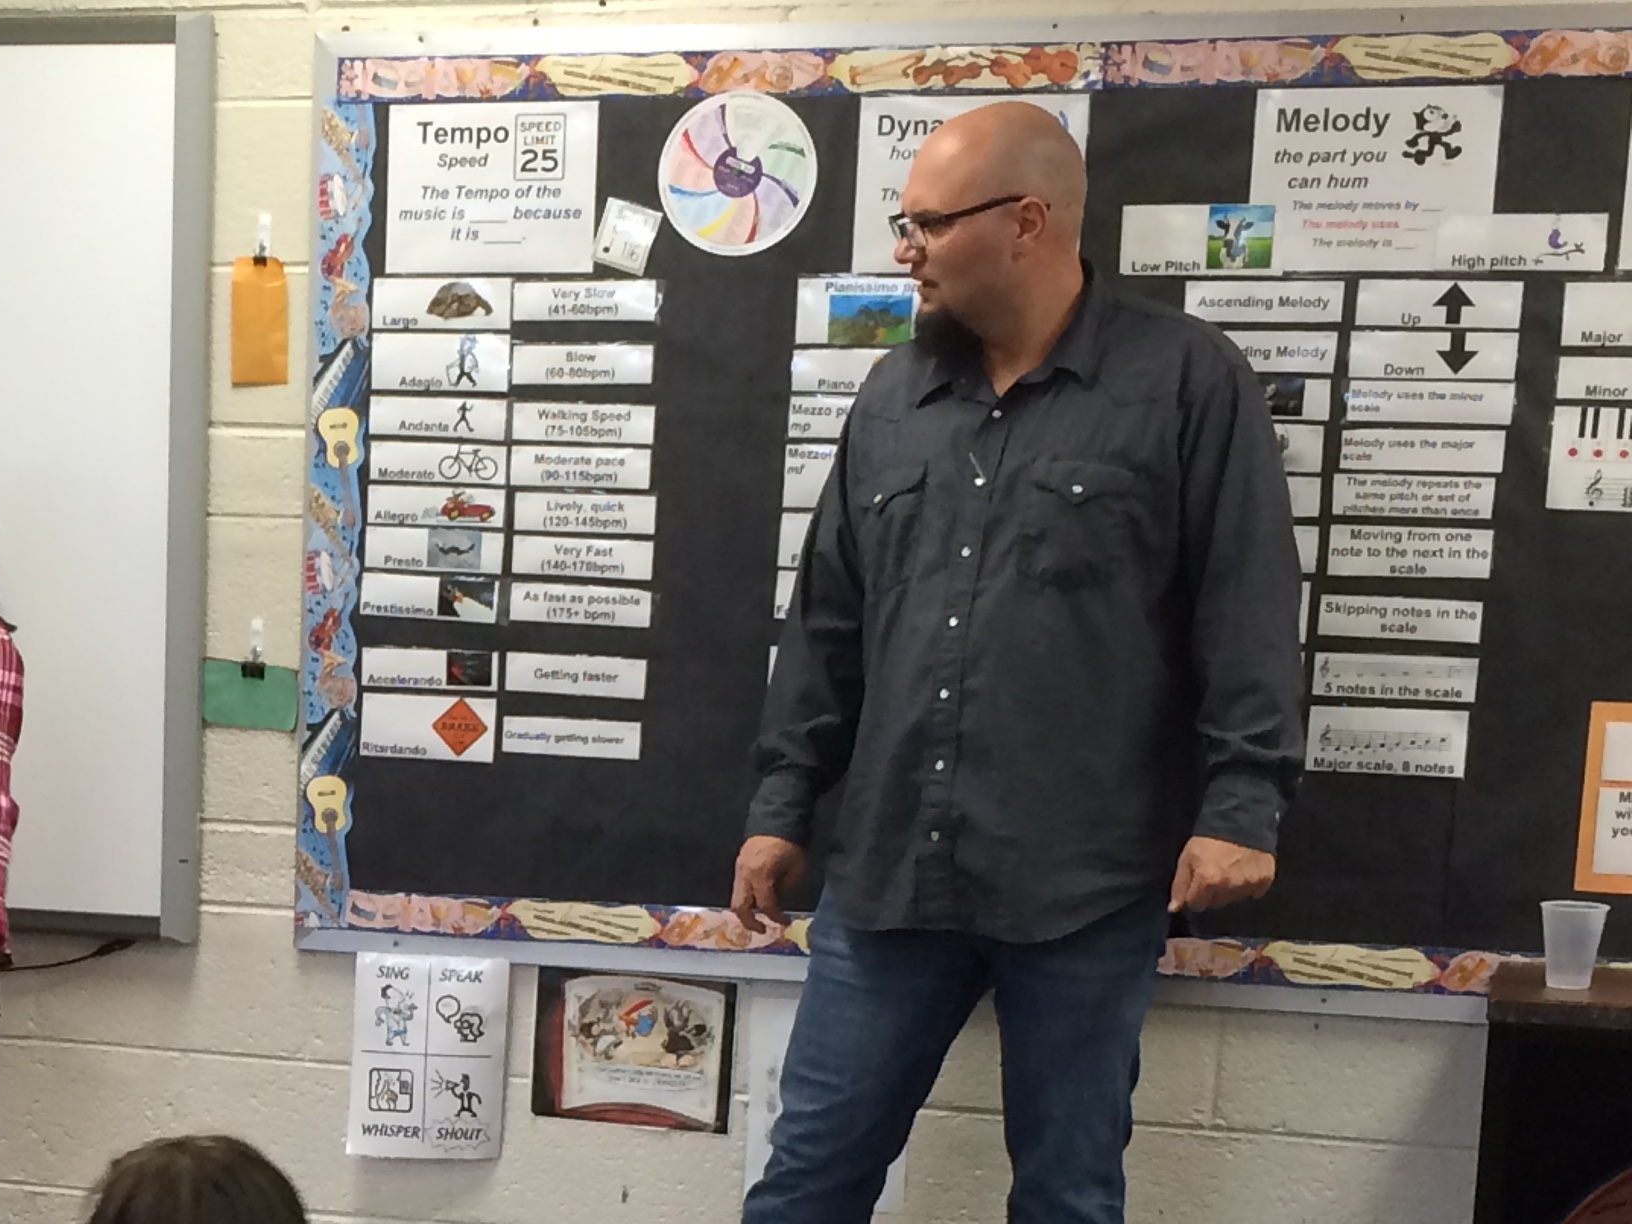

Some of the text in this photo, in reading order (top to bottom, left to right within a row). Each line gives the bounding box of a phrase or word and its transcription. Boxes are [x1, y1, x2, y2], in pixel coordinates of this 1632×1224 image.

[520, 121, 561, 133] SPEED
[877, 115, 944, 142] Dyna
[1276, 107, 1390, 138] Melody
[417, 121, 509, 149] Tempo
[524, 135, 556, 146] LIMIT
[437, 153, 489, 170] Speed
[520, 149, 559, 173] 25
[1274, 149, 1387, 167] the part you
[1288, 175, 1369, 189] can hum
[421, 185, 561, 202] The Tempo of the
[399, 206, 582, 221] music is because
[1292, 201, 1419, 212] The melody moves by
[1302, 220, 1399, 231] The melody uses
[450, 227, 479, 241] it is
[1312, 238, 1379, 249] The melody
[1132, 260, 1200, 273] Low Pitch
[1451, 254, 1527, 270] High pitch
[552, 288, 616, 300] Very Slow
[826, 282, 898, 293] Pianissimo
[1197, 296, 1330, 311] Ascending Melody
[382, 316, 418, 329] Largo
[1401, 313, 1421, 327] Up
[1581, 330, 1623, 347] Major
[566, 352, 596, 363] Slow
[1276, 346, 1327, 360] Melody
[545, 366, 616, 380] (60-80bpm)
[1384, 364, 1425, 377] Down
[399, 376, 443, 390] Adagio
[818, 379, 855, 390] Piano
[1352, 389, 1484, 401] Melody uses the minor
[1585, 385, 1628, 398] Minor
[791, 404, 832, 416] Mezzo
[1350, 402, 1380, 412] scale
[537, 409, 631, 424] Walking Speed
[399, 420, 449, 432] Andante
[790, 422, 811, 434] mp
[1344, 437, 1475, 451] Melody uses the major
[534, 454, 625, 469] Moderate pace
[1342, 451, 1372, 461] scale
[378, 468, 435, 480] Moderato
[787, 464, 805, 475] mf
[1347, 477, 1482, 490] The melody repeats the
[1390, 490, 1417, 501] pitch
[1437, 492, 1455, 501] set
[1458, 492, 1470, 502] of
[590, 502, 625, 515] quick
[1421, 505, 1446, 515] than
[1451, 507, 1479, 516] once
[375, 511, 418, 524] Allegro
[1350, 528, 1472, 543] Moving from one
[554, 545, 613, 558] Very Fast
[1331, 546, 1488, 560] note to the next in the
[384, 555, 423, 568] Presto
[1389, 563, 1427, 575] scale
[523, 591, 641, 607] As fast as possible
[362, 602, 434, 617] Prestissimo
[584, 609, 615, 623] bpm)
[1325, 602, 1477, 620] Skipping notes in the
[1380, 622, 1417, 634] scale
[367, 674, 443, 686] Accelerando
[534, 668, 619, 683] Getting faster
[1324, 682, 1462, 698] 5 notes in the scale
[504, 729, 625, 746] Gradually getting slower
[1314, 756, 1352, 771] Major
[1402, 761, 1410, 772] 8
[1415, 763, 1454, 774] notes
[376, 965, 484, 983] SING SPEAK
[361, 1123, 483, 1141] WHISPER SHOUT
